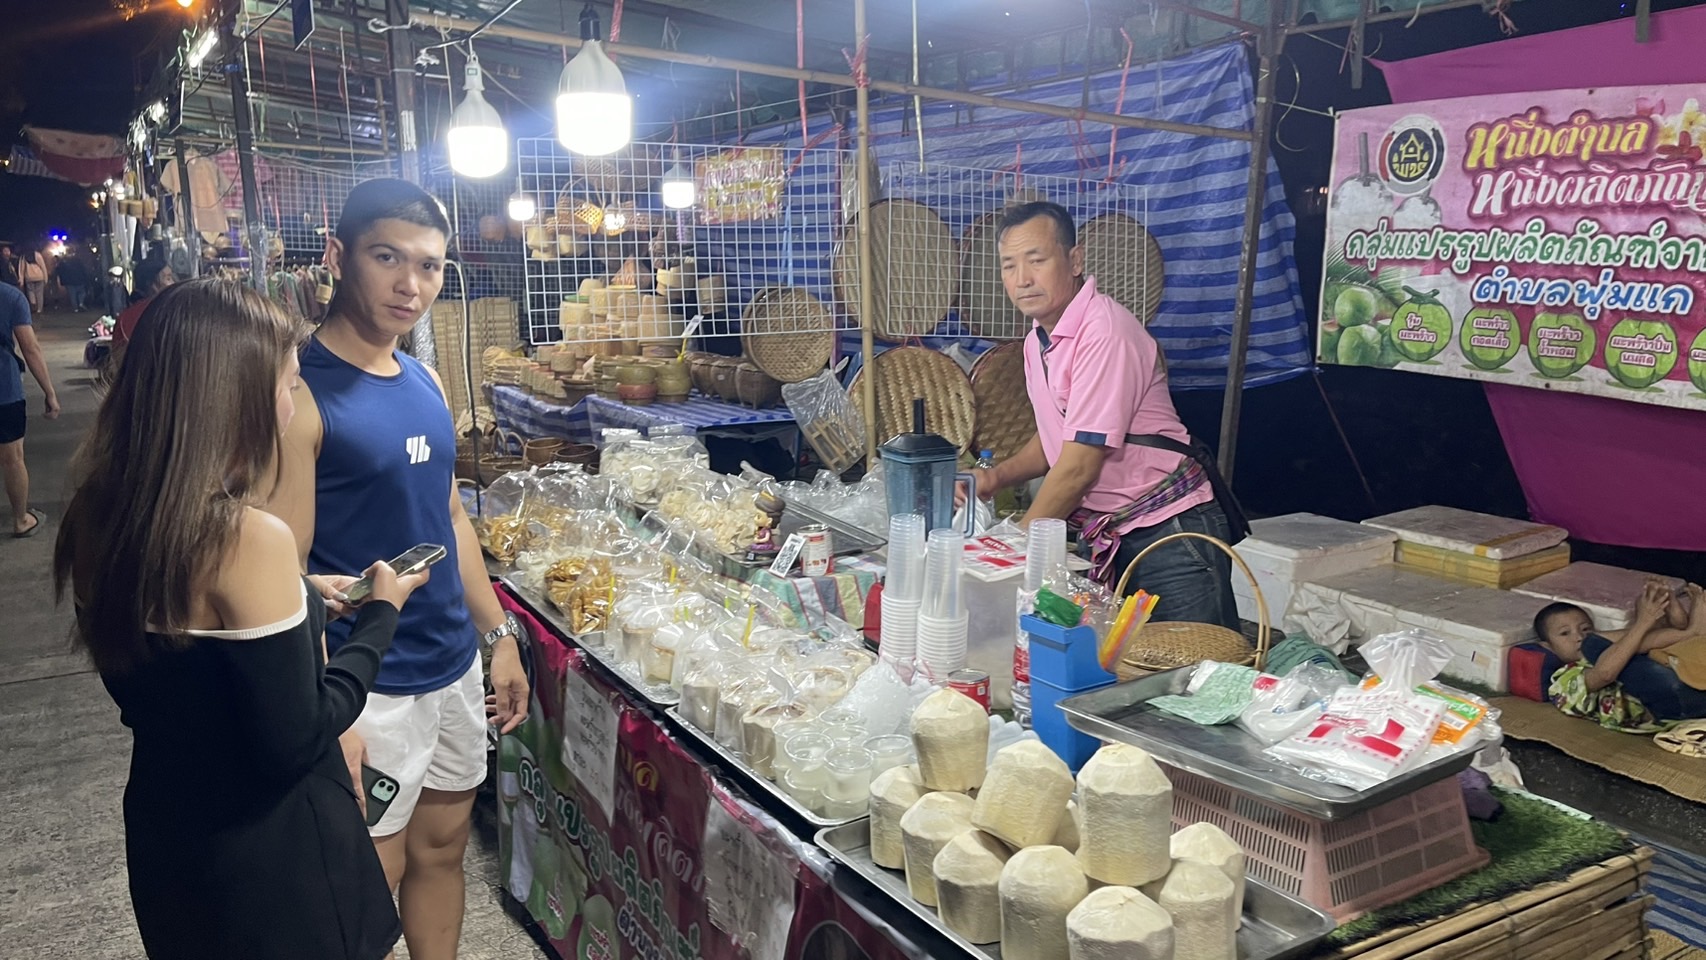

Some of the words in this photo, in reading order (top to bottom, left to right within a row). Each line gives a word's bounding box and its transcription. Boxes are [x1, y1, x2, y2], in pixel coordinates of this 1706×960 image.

[1466, 112, 1649, 169] หนึ่งตำบล
[1346, 217, 1706, 273] กลุ่มแปรรูปผลิตภัณฑ์จา
[1475, 316, 1509, 329] มะพร้าว
[1399, 329, 1436, 341] มะพร้าว
[1539, 327, 1581, 340] มะพร้าว
